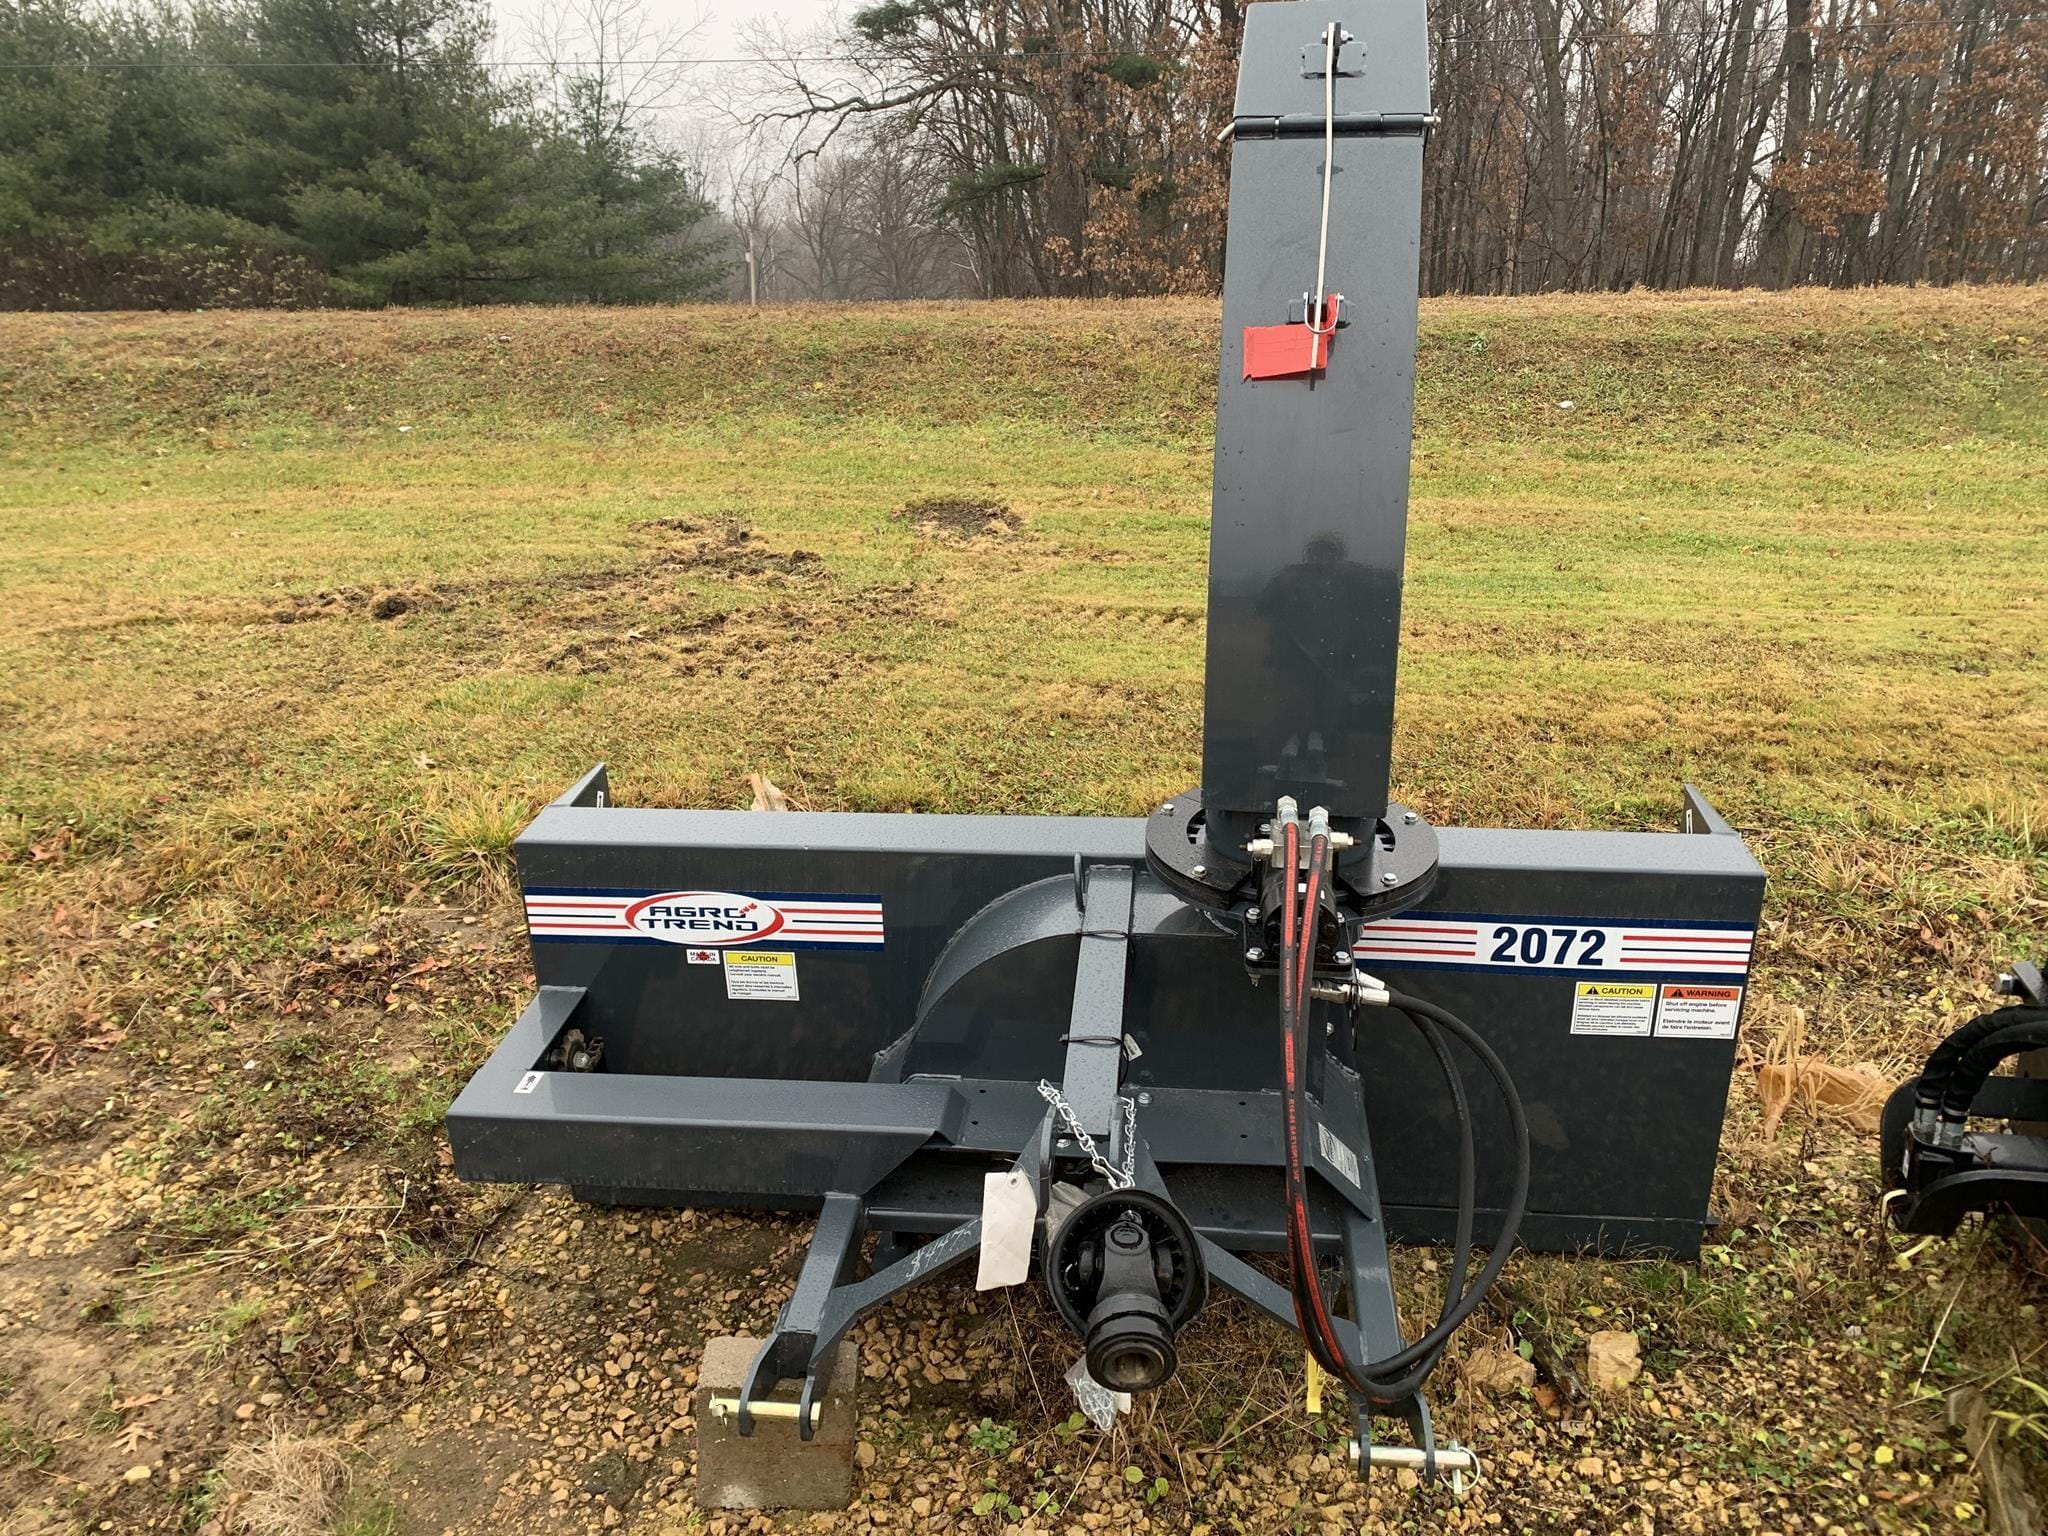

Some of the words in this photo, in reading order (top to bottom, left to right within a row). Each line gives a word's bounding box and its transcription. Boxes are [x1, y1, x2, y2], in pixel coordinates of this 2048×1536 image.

[650, 906, 746, 919] AGRO
[640, 918, 758, 931] TREND
[1490, 926, 1606, 966] 2072
[741, 955, 778, 963] CAUTION
[1601, 987, 1643, 995] CAUTION
[1686, 990, 1731, 998] WARNING
